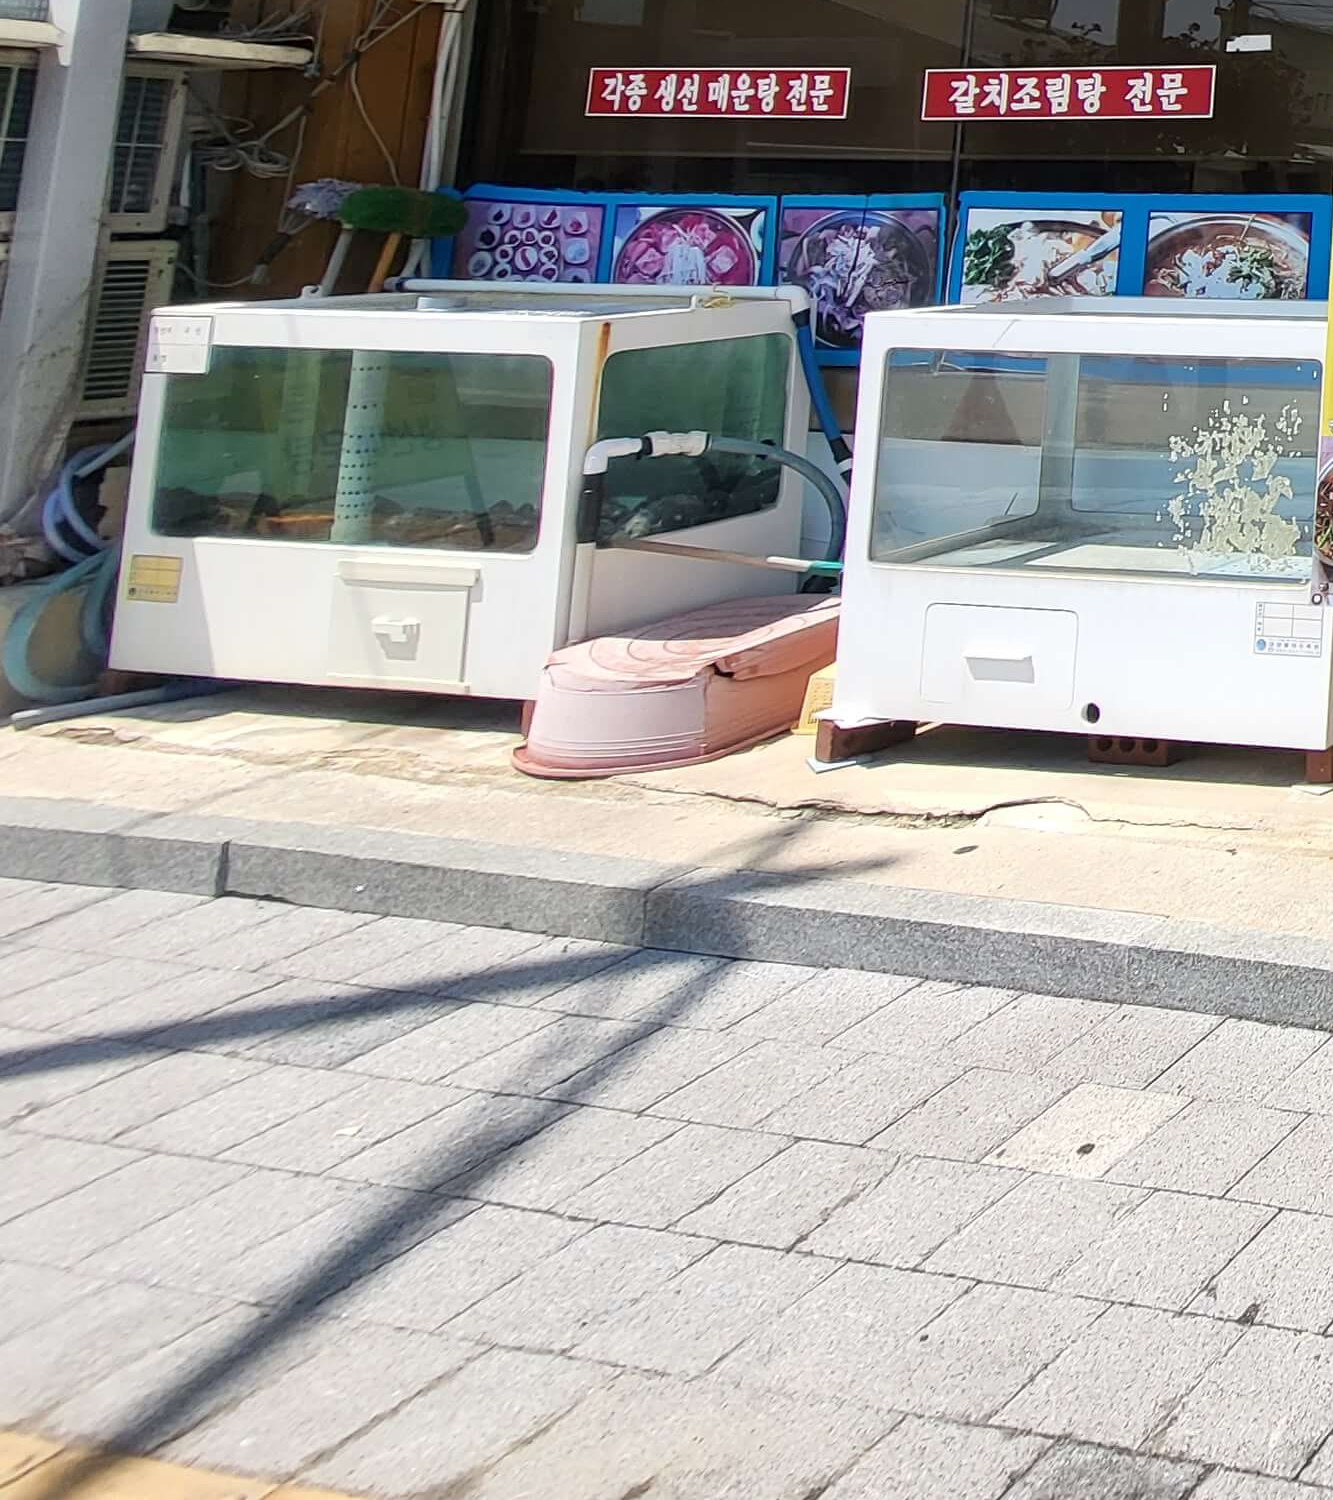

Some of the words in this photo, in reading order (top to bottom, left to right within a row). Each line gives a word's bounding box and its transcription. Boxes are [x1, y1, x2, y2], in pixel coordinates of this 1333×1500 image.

[601, 75, 648, 109] 각종
[652, 74, 701, 109] 생선
[705, 74, 781, 110] 매운탕
[786, 74, 835, 109] 전문
[948, 74, 1108, 113] 갈치조림탕
[1123, 74, 1190, 111] 전문
